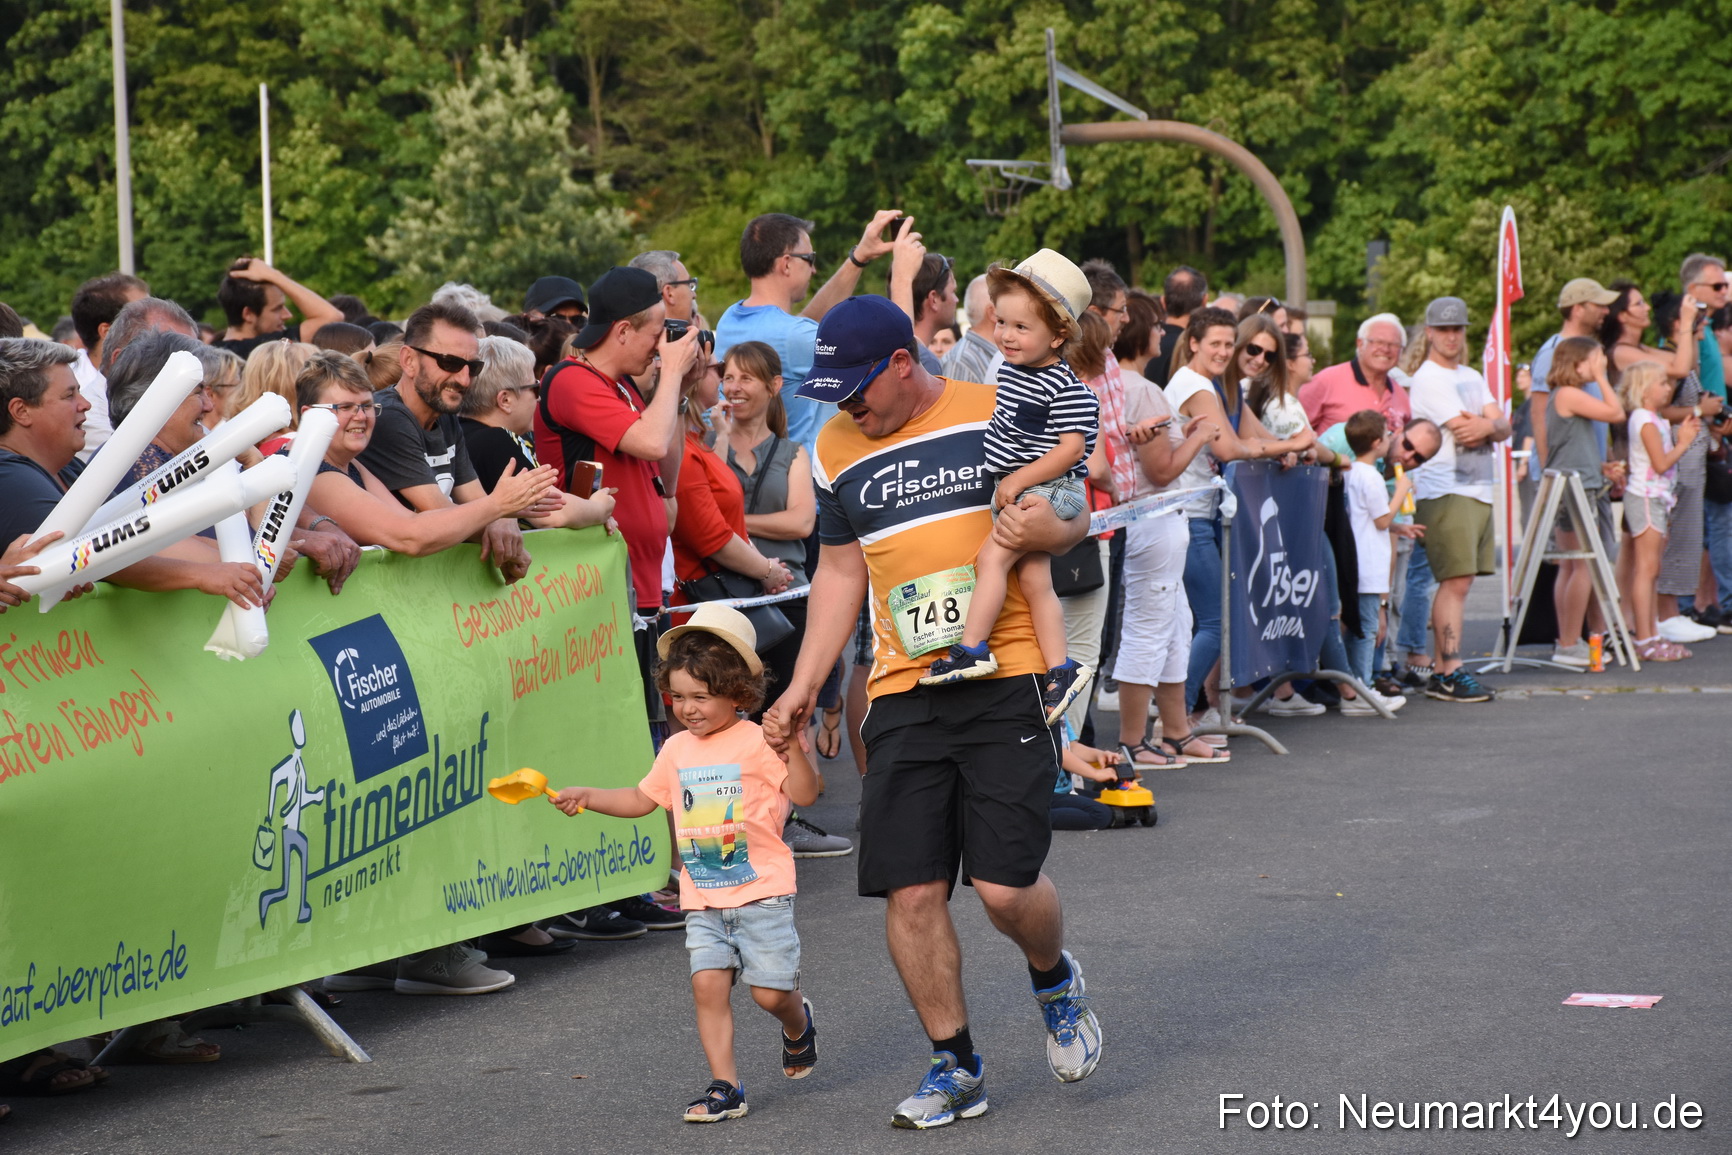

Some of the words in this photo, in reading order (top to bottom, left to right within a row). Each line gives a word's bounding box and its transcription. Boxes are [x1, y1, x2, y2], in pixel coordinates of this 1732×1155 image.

[882, 465, 987, 502] Fischer
[896, 480, 983, 509] AUTOMOBILE
[452, 582, 541, 648] Gesunde
[534, 563, 604, 614] Firmen
[954, 585, 971, 594] 2019
[907, 597, 960, 634] 748
[913, 630, 935, 642] Fischer
[0, 629, 104, 689] Firmen
[508, 633, 562, 702] laufen
[564, 601, 623, 684] länger!
[347, 663, 398, 700] Fischer
[361, 687, 401, 714] AUTOMOBILE
[0, 709, 74, 784] aufen
[57, 668, 173, 757] länger!
[323, 711, 489, 869] firmenlauf
[716, 785, 743, 796] 6708
[323, 848, 402, 909] neumarkt
[442, 824, 656, 914] www.firmenlauf-oberpfalz.de
[0, 929, 189, 1027] auf-oberpfalz.de
